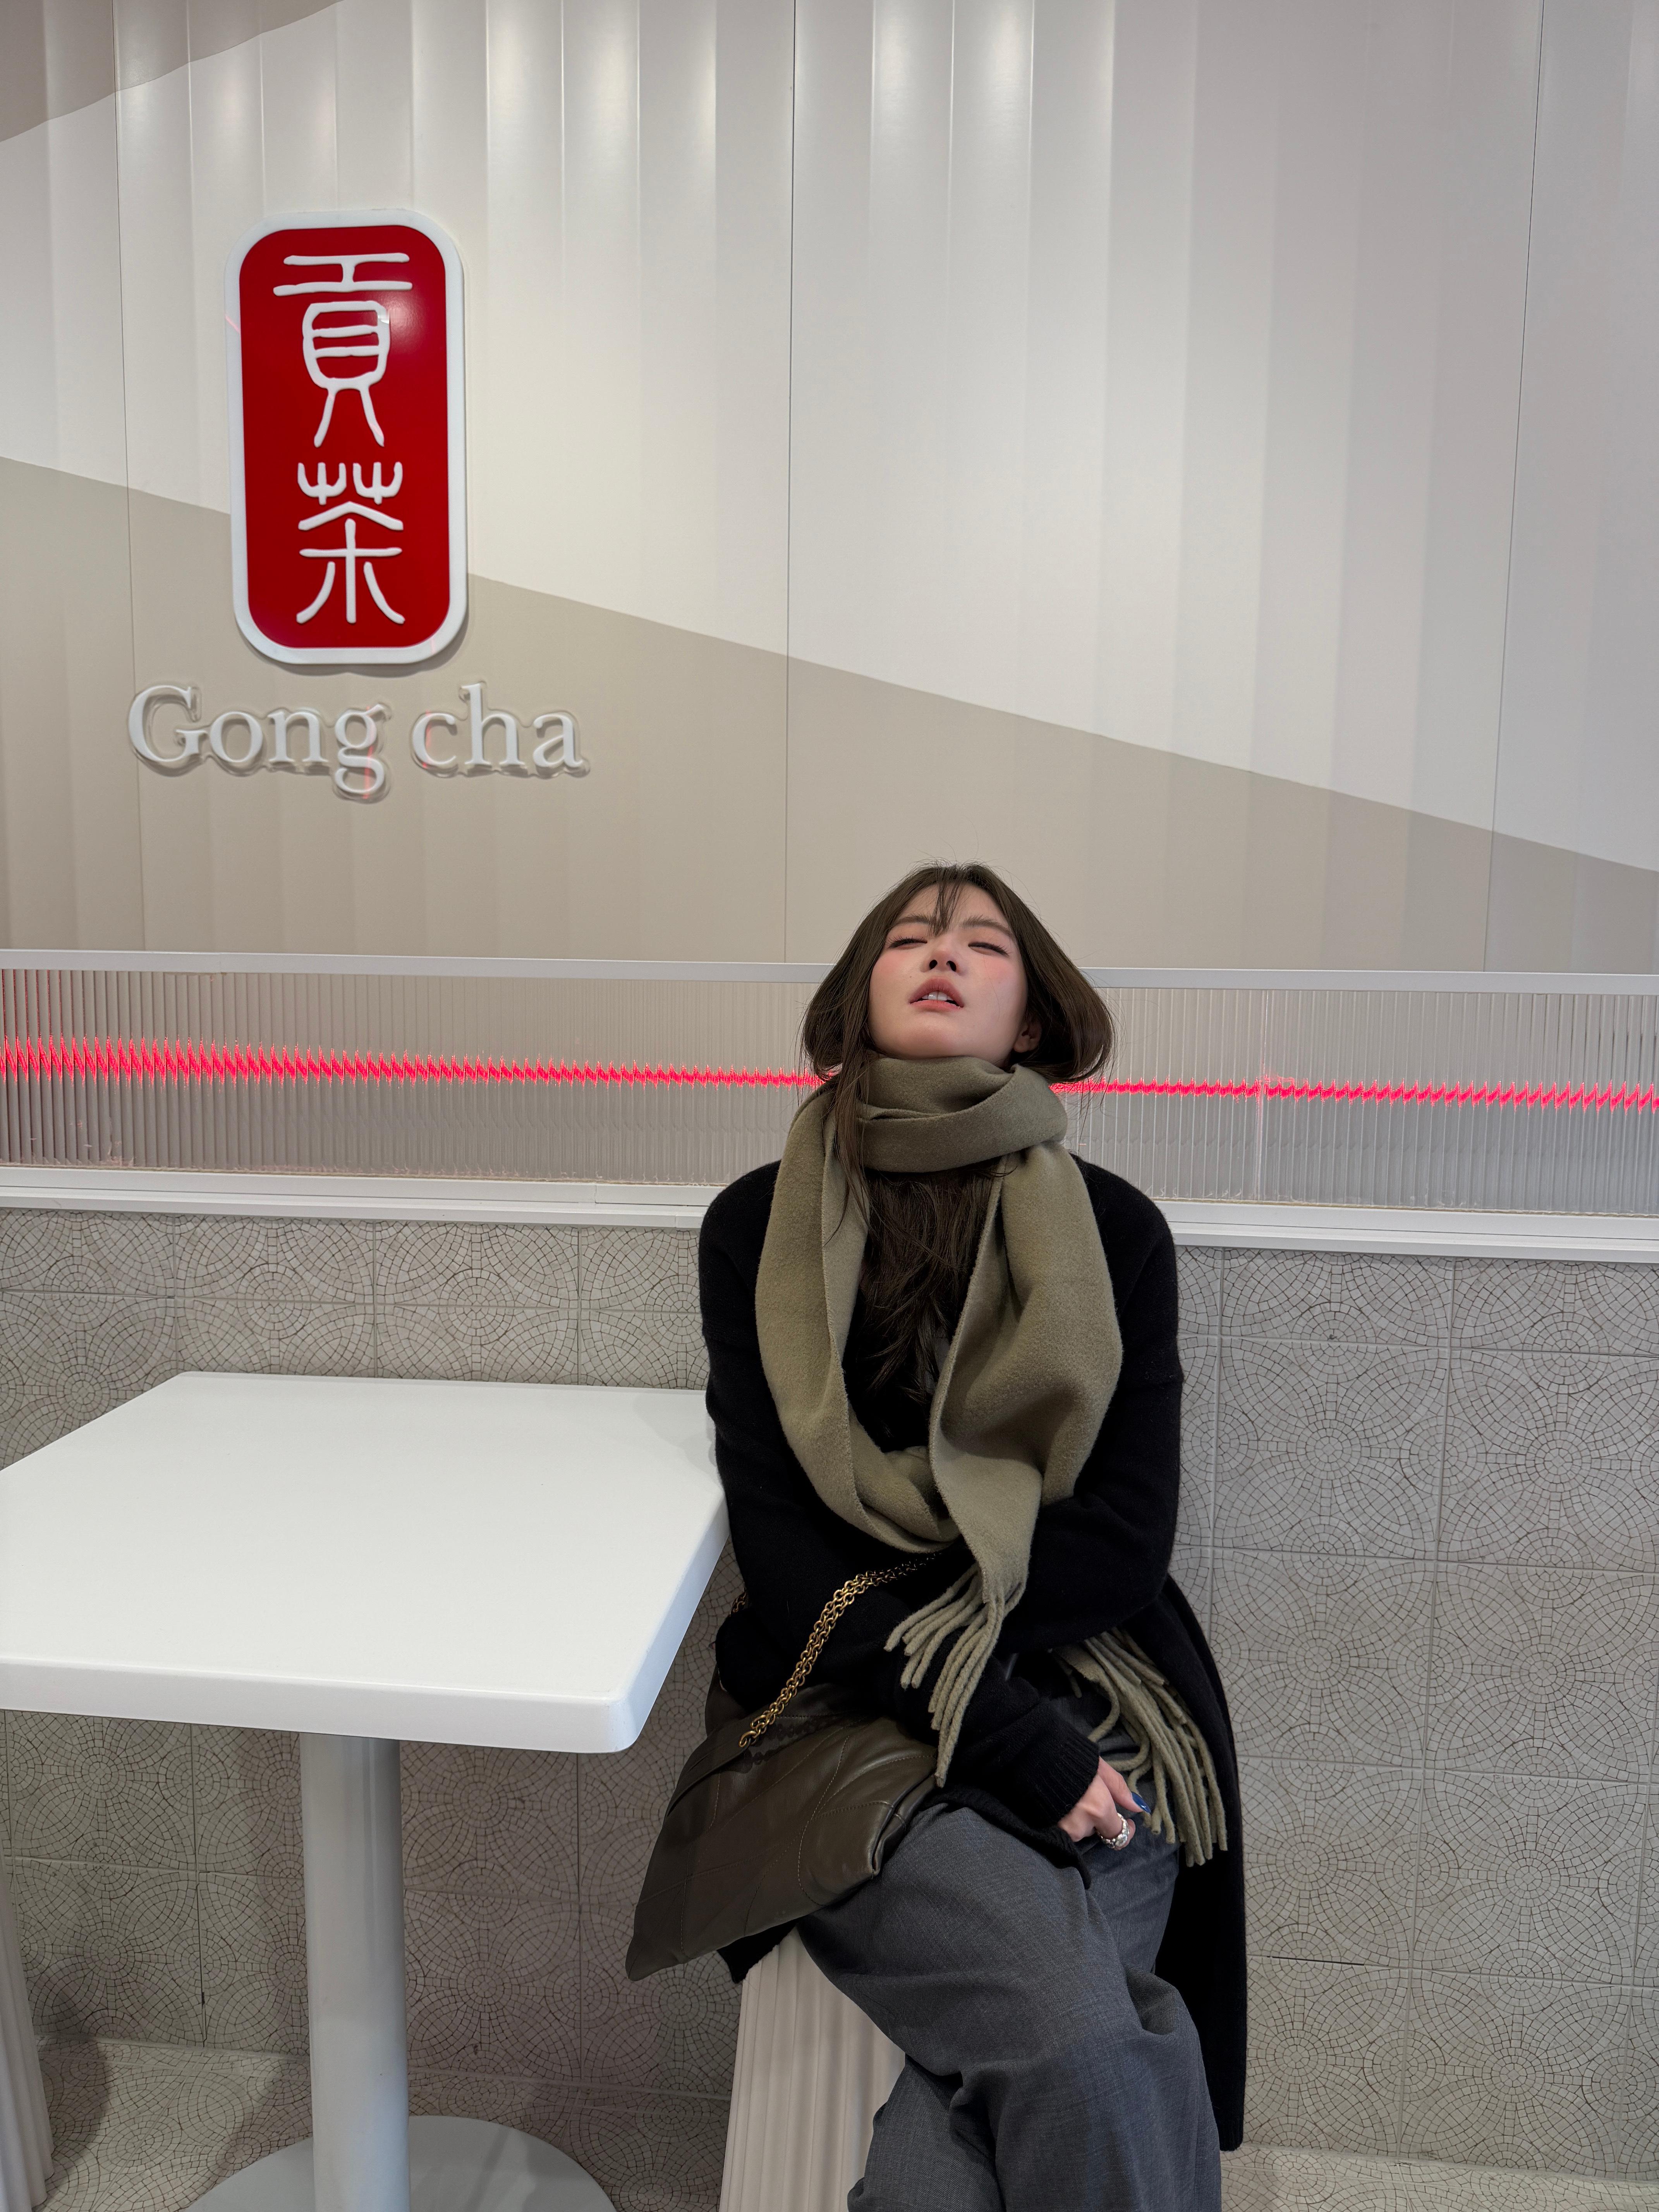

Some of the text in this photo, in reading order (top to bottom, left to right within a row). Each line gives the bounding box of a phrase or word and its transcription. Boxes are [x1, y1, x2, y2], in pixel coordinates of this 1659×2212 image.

[273, 253, 413, 623] 貢茶
[129, 682, 583, 795] Gong cha
